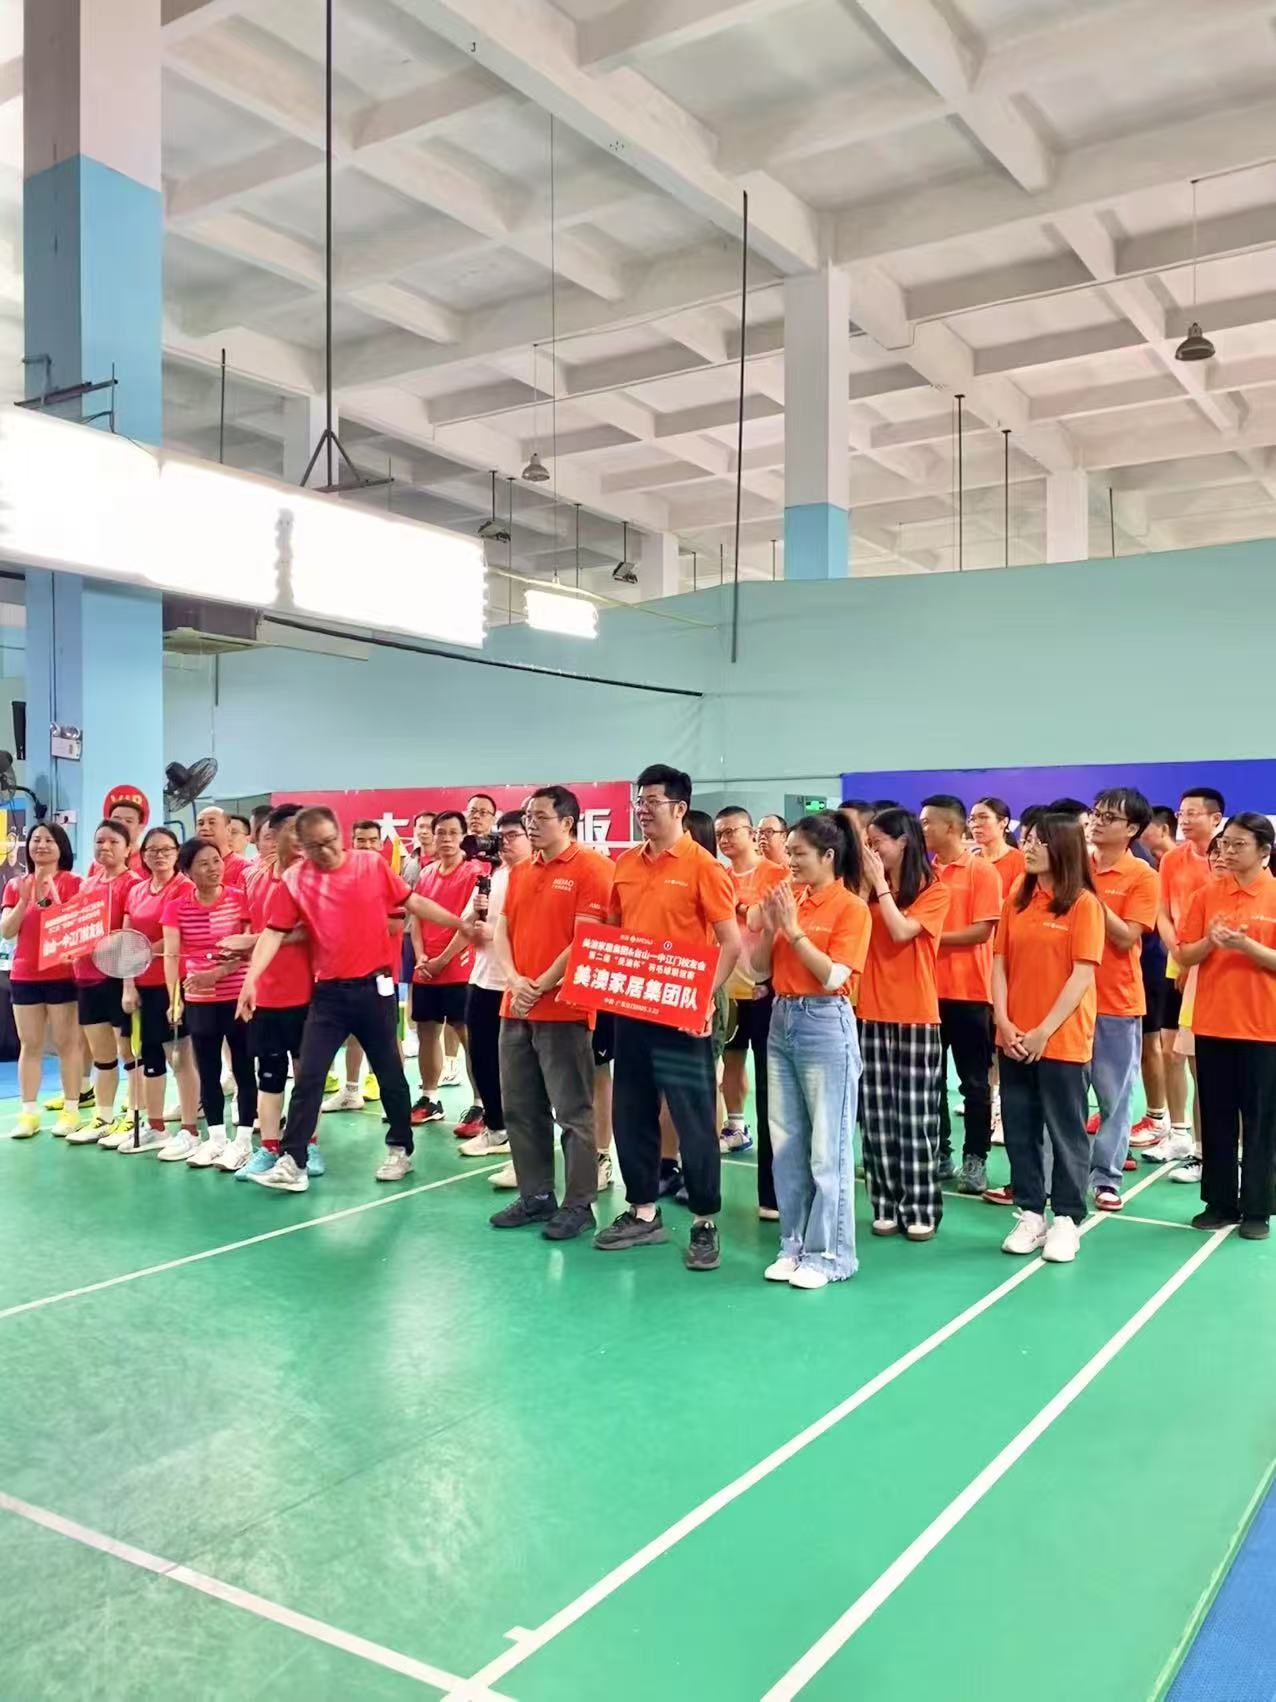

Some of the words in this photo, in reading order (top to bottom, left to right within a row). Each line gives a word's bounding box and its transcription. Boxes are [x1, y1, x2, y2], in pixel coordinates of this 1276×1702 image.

[573, 964, 698, 1011] 美澳家居集团队
